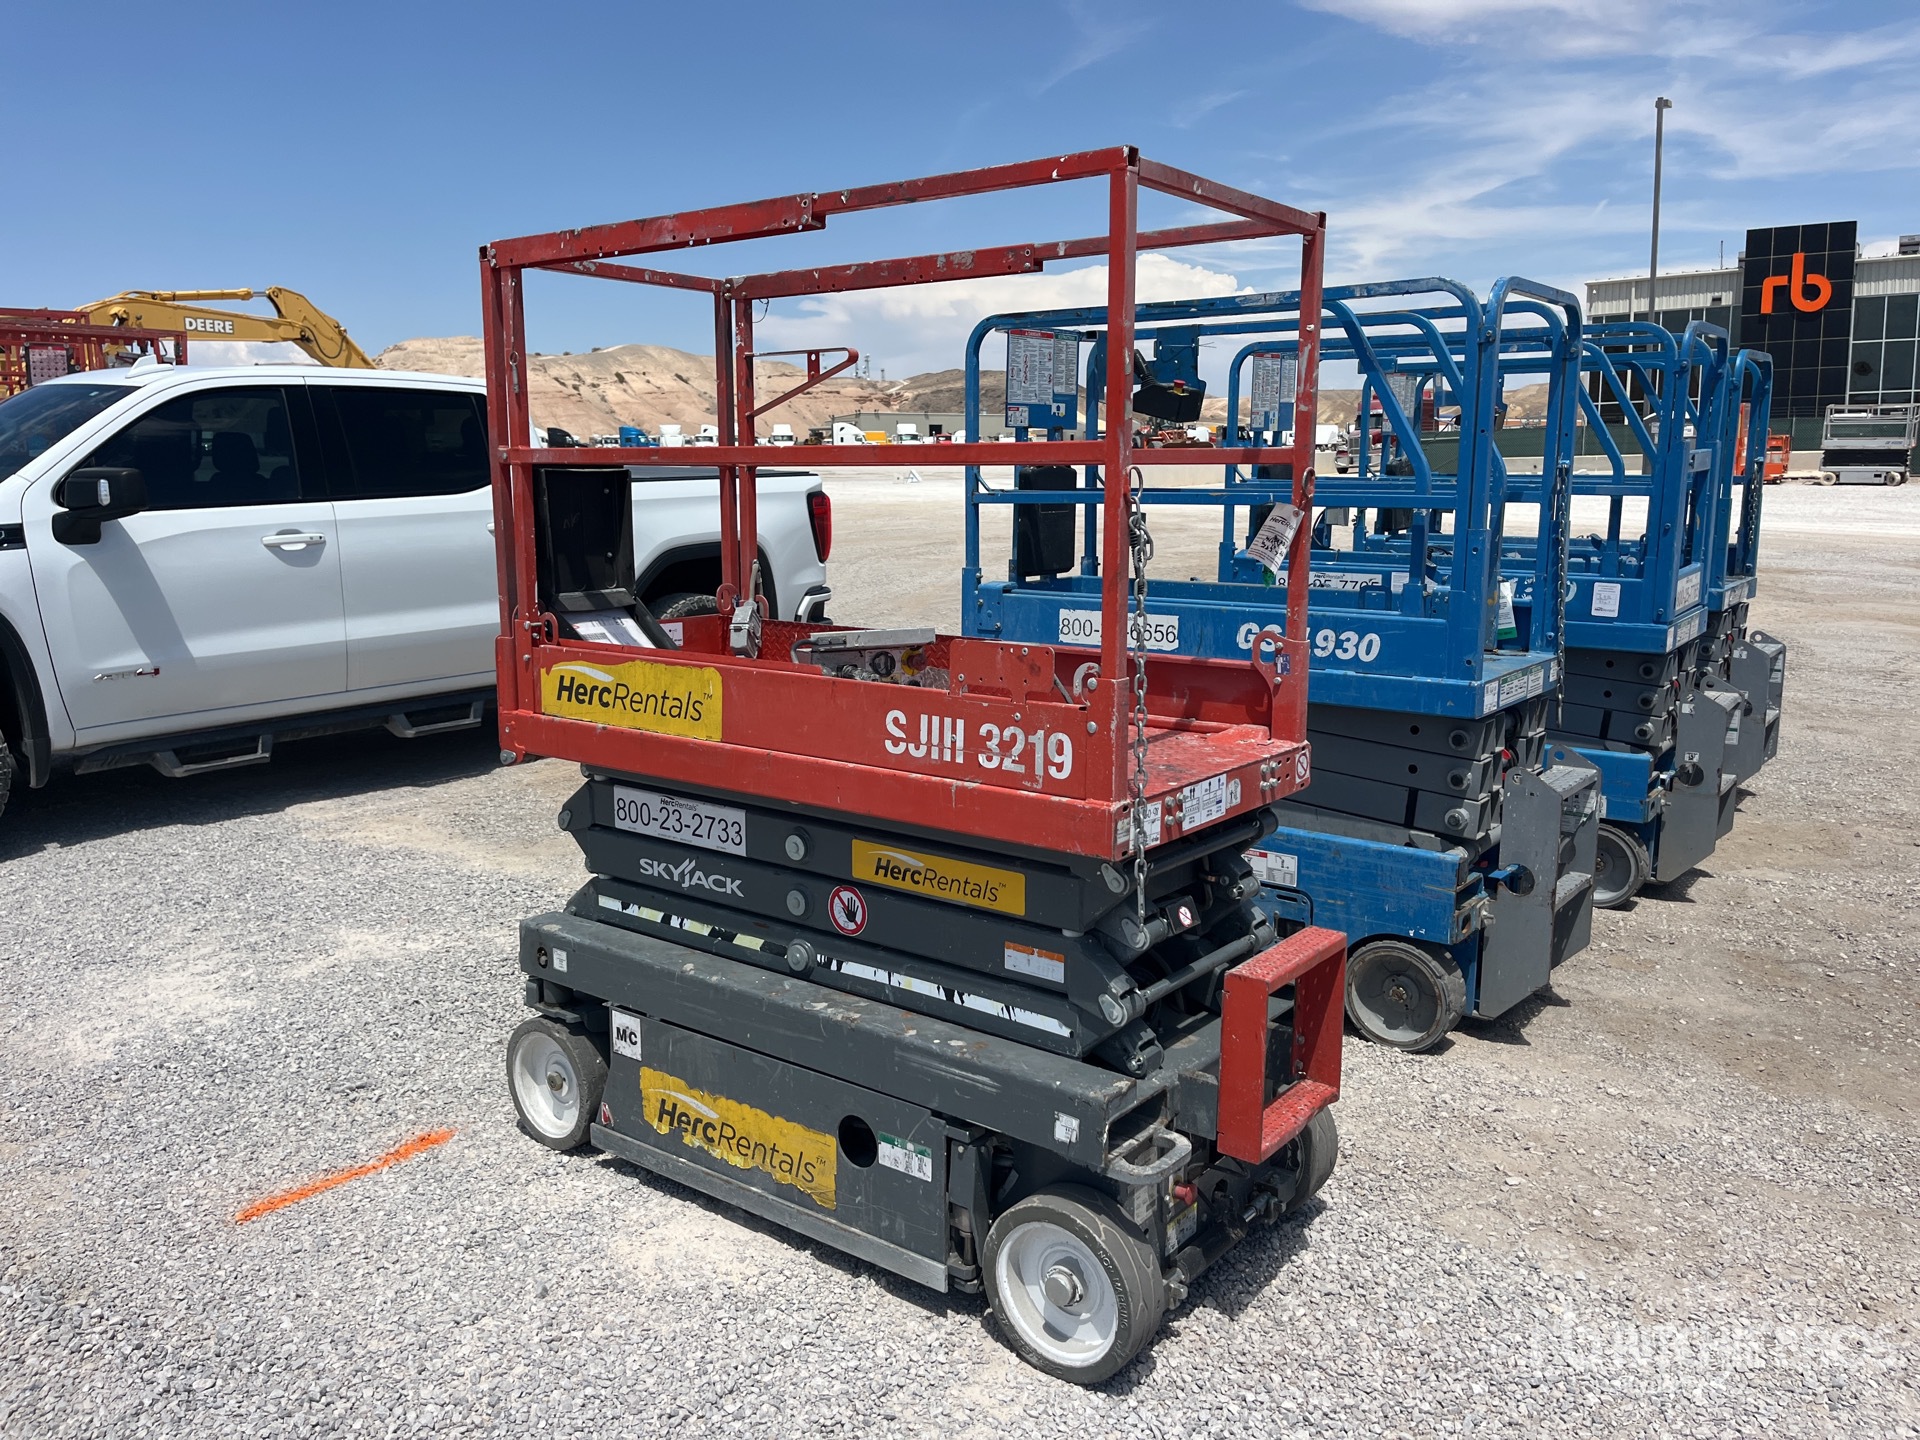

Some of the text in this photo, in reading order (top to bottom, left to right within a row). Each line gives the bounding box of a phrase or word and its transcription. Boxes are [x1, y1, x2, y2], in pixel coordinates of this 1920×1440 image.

[1761, 252, 1832, 314] rb
[185, 317, 233, 333] DEERE
[1060, 617, 1177, 644] 800--6656
[978, 722, 1073, 780] 3219
[616, 797, 743, 846] 800-23-2733
[639, 858, 745, 898] SKYJACK
